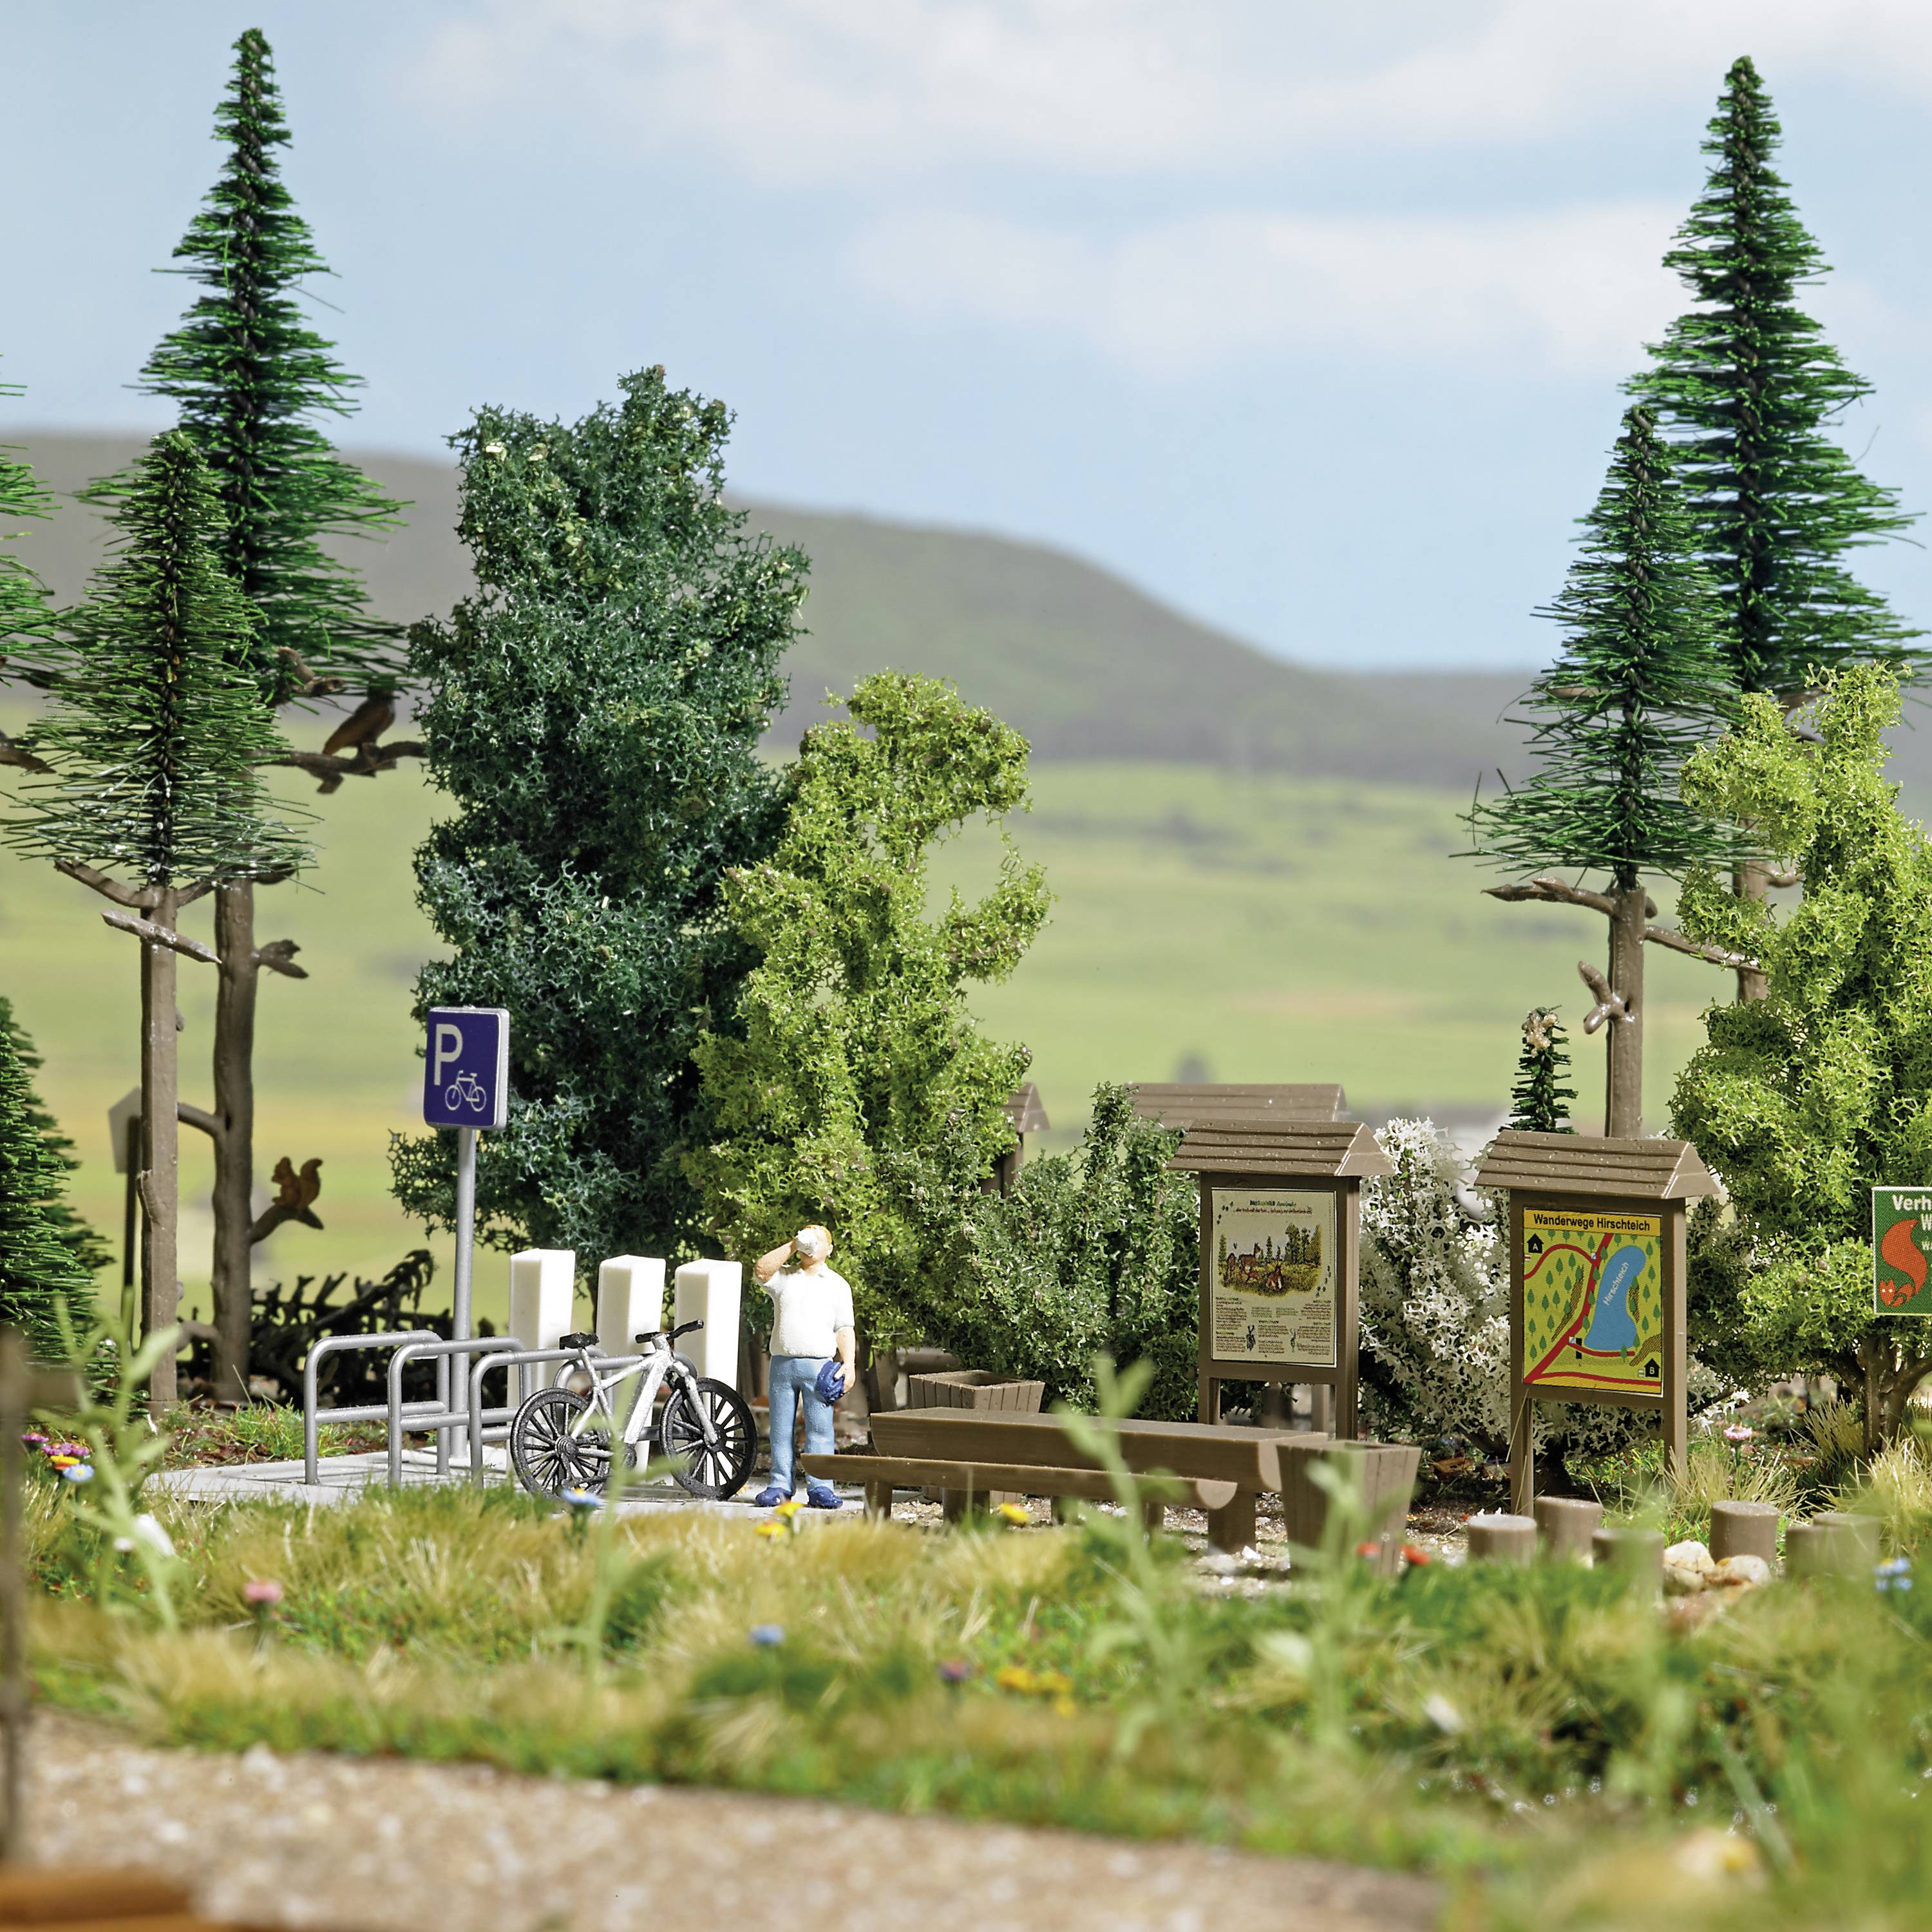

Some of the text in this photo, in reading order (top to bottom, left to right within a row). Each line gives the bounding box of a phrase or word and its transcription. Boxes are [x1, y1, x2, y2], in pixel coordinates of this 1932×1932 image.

[435, 1023, 463, 1086] P
[1892, 1195, 1932, 1211] Verh
[1533, 1214, 1650, 1231] Wanderwege Hirschteich
[1603, 1262, 1629, 1306] Hirschteich
[1649, 1367, 1655, 1375] B
